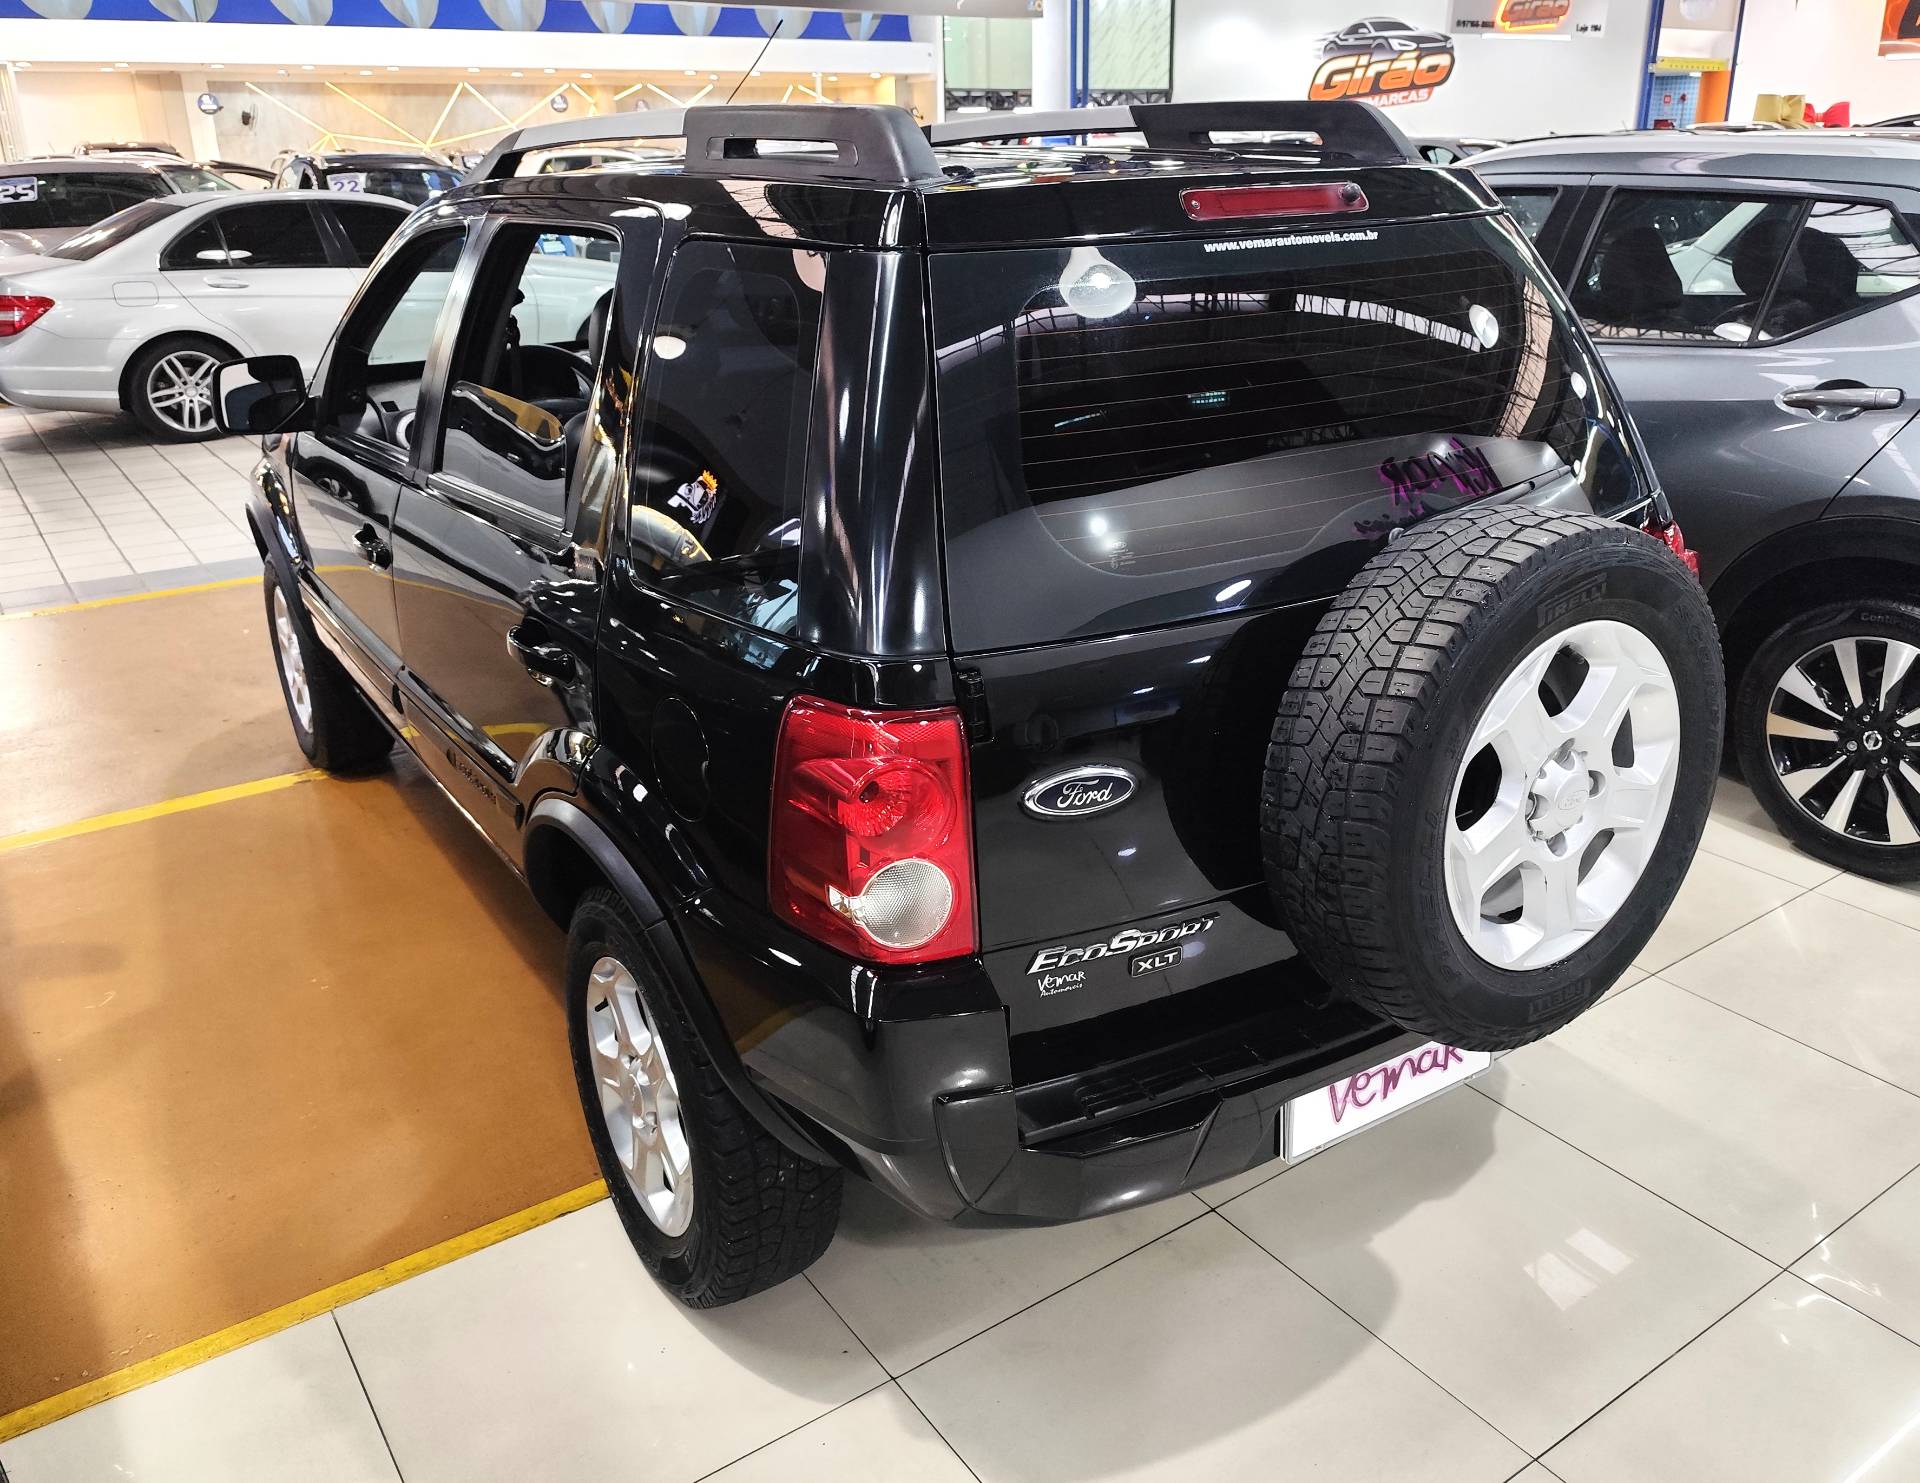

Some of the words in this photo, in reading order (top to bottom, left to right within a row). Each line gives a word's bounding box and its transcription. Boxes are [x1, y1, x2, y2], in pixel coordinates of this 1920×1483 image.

[1203, 230, 1379, 253] www.vemarautomoveis.com.br
[1056, 778, 1113, 809] Ford
[1137, 951, 1178, 973] XLT
